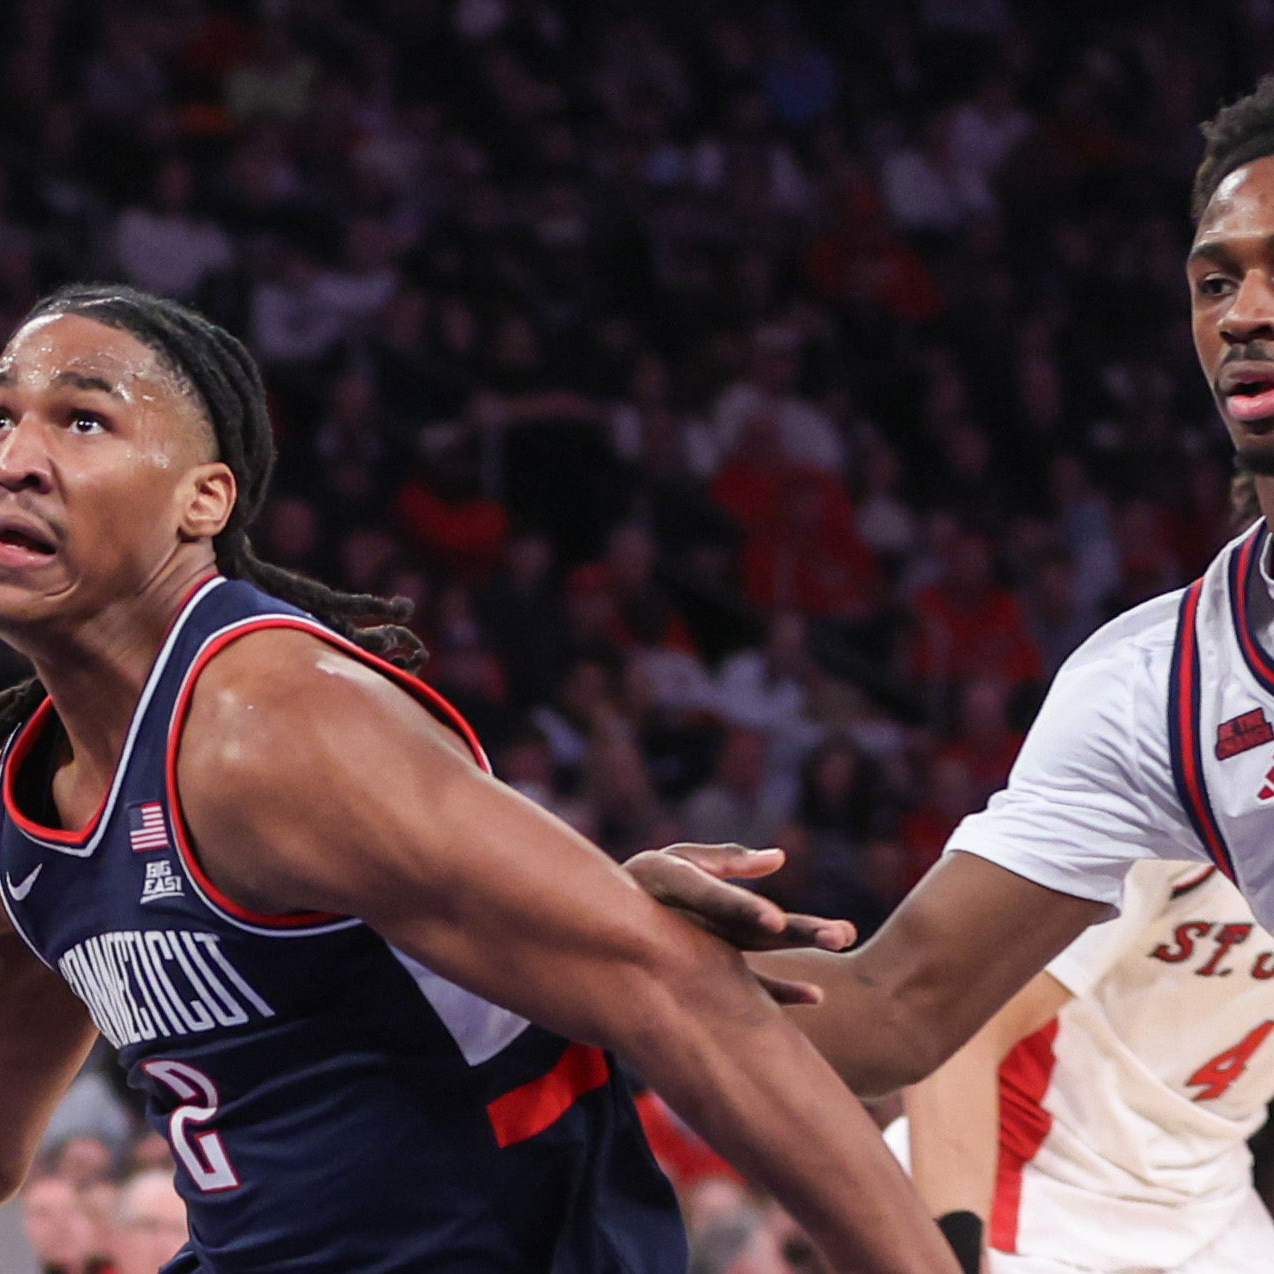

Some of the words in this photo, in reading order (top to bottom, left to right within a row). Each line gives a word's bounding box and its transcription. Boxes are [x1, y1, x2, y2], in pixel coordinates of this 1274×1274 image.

[146, 860, 171, 878] BIG
[143, 876, 182, 895] EAST
[141, 1059, 240, 1193] 2
